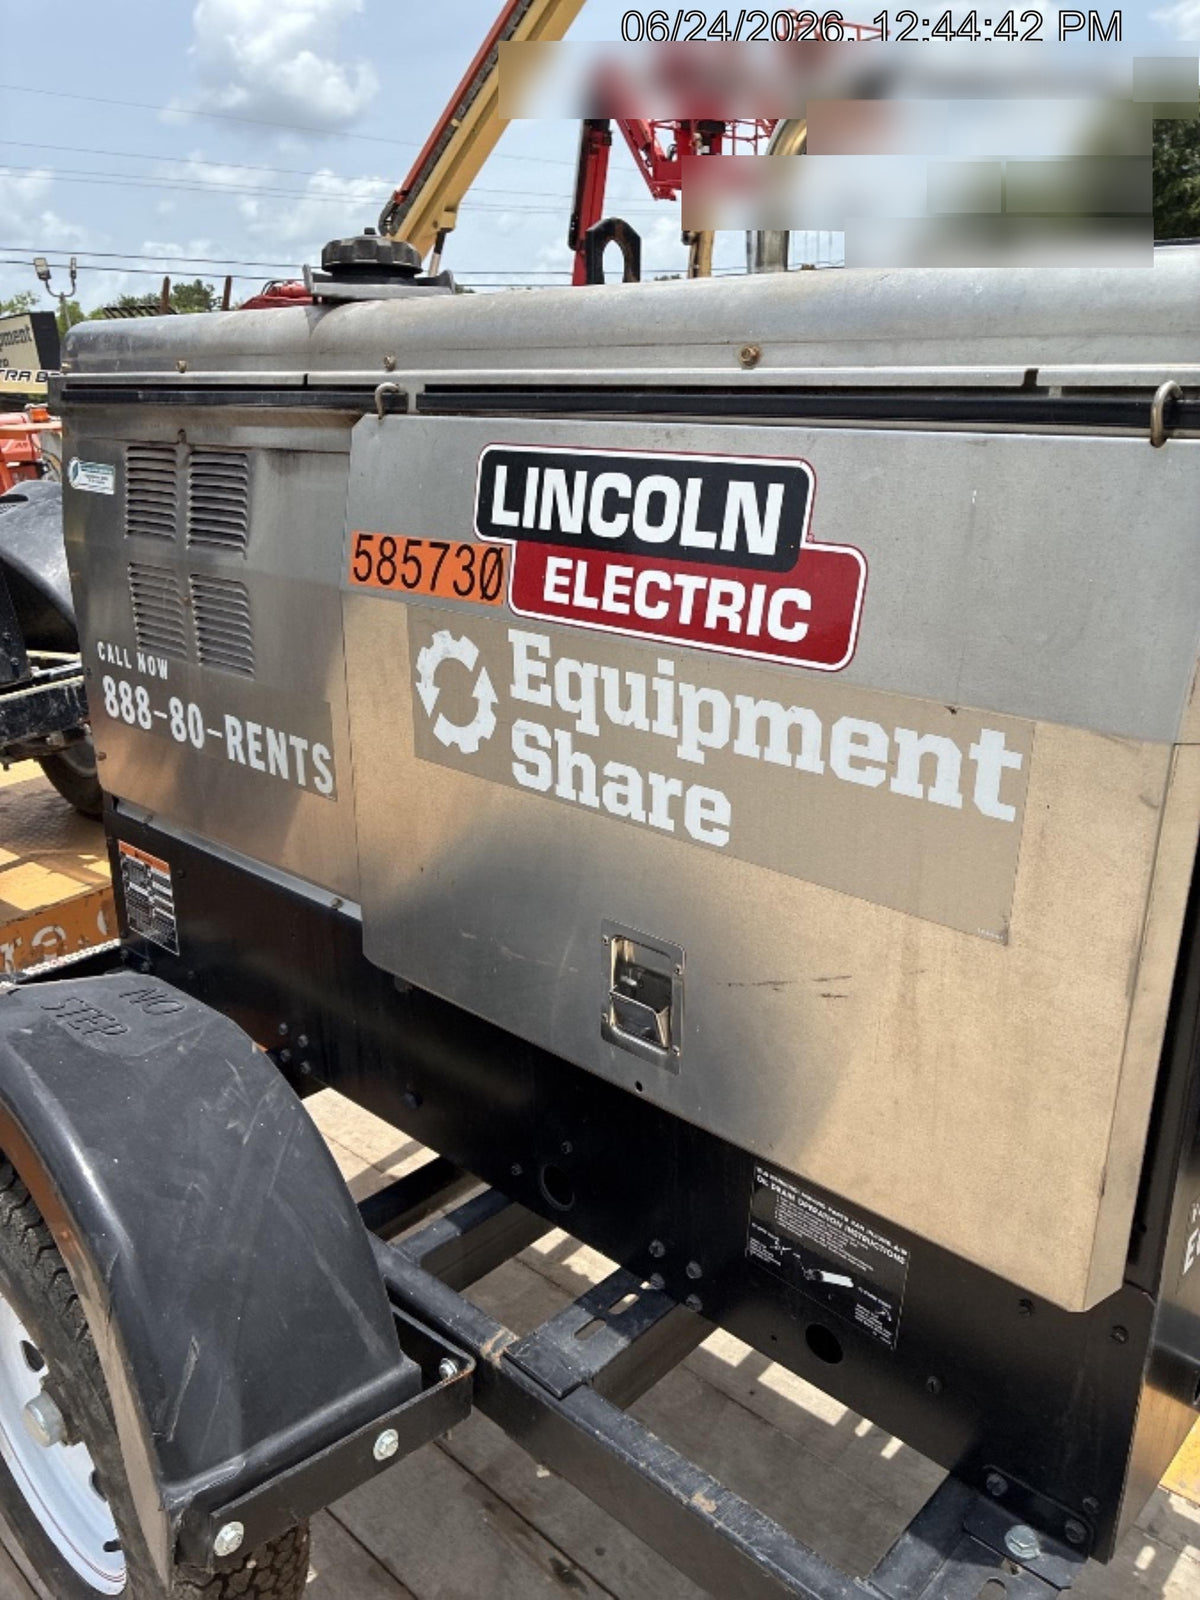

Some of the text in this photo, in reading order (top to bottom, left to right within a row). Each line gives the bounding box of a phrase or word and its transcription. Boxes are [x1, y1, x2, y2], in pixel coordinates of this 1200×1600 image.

[490, 464, 786, 556] LINCOLN
[352, 534, 504, 601] 585730
[543, 556, 812, 643] ELECTRIC
[96, 641, 168, 680] CALL NOW
[102, 675, 334, 794] 888-80-RENTS
[508, 628, 1023, 822] Equipment
[511, 718, 732, 848] Share
[40, 997, 128, 1036] STEP
[119, 988, 185, 1016] NO
[771, 1182, 796, 1201] DRAIN
[797, 1198, 843, 1228] OPERATION
[844, 1224, 905, 1265] INSTRUCTIONS
